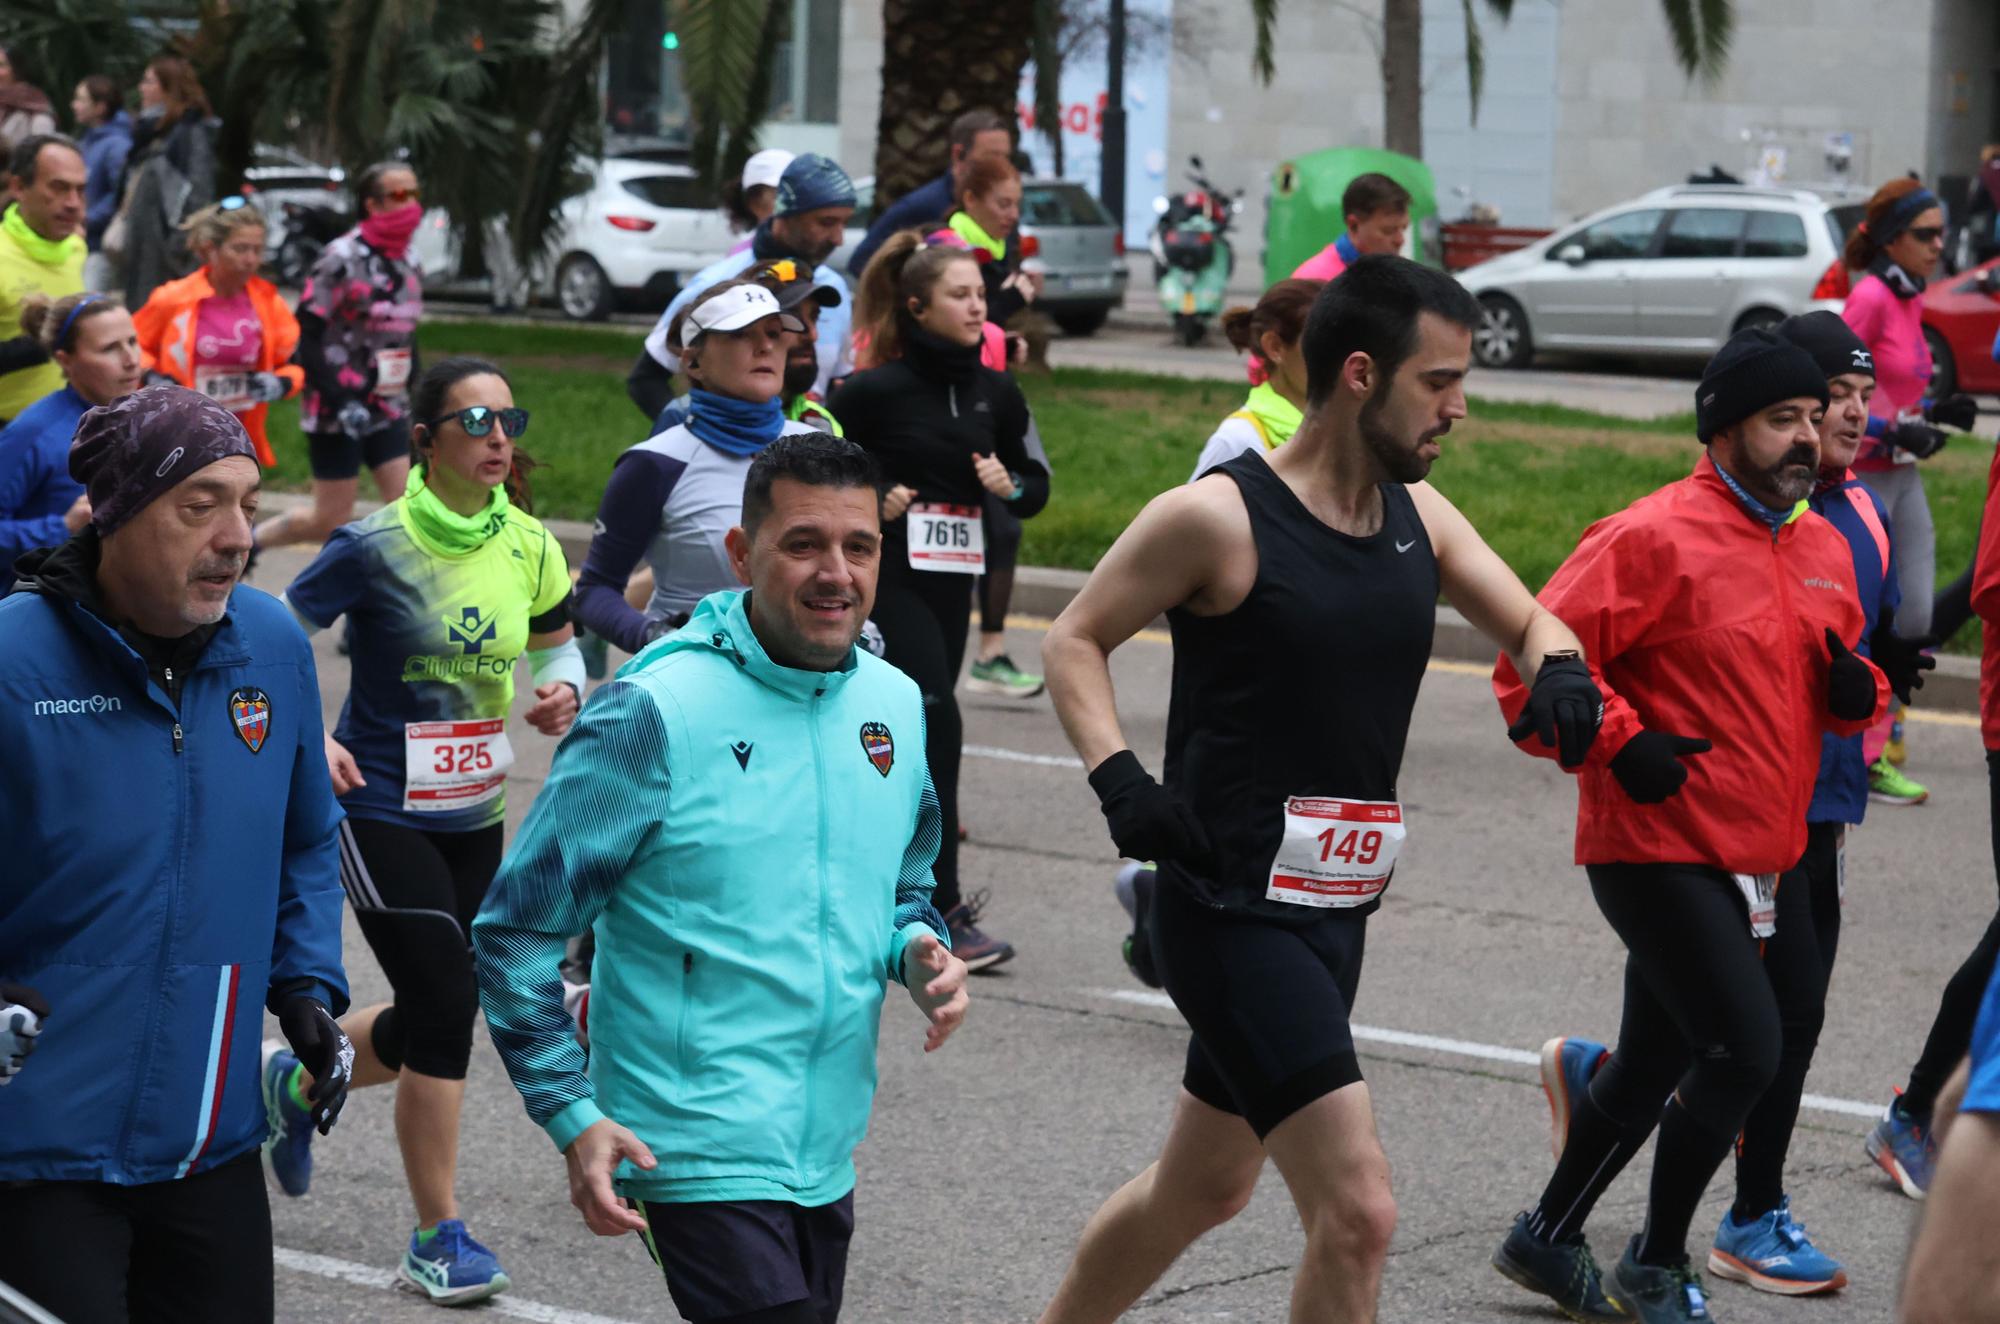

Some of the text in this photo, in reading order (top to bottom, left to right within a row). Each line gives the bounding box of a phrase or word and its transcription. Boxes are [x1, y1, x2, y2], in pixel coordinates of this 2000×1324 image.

[924, 520, 969, 547] 7615
[34, 695, 122, 715] macron
[433, 741, 493, 773] 325
[1318, 827, 1384, 864] 149
